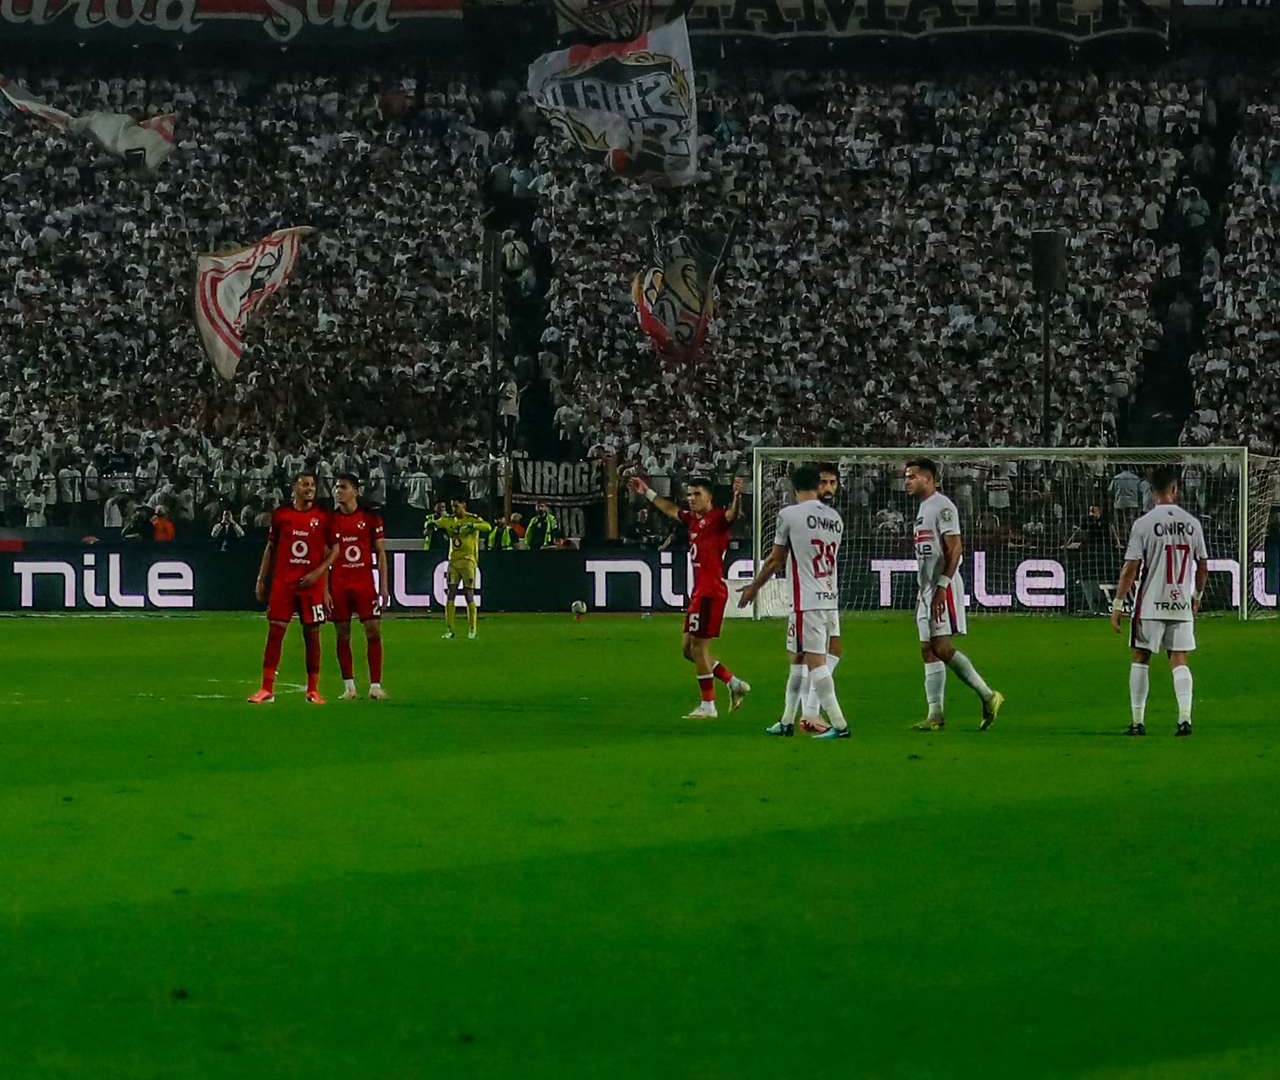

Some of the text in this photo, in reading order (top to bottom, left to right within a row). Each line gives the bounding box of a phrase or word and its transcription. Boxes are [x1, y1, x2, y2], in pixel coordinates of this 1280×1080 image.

[517, 459, 602, 495] VIRAGE
[1153, 522, 1194, 537] ONIRO
[12, 552, 195, 608] nile
[871, 551, 1066, 607] nle
[1164, 544, 1191, 585] 17
[312, 604, 325, 622] 15
